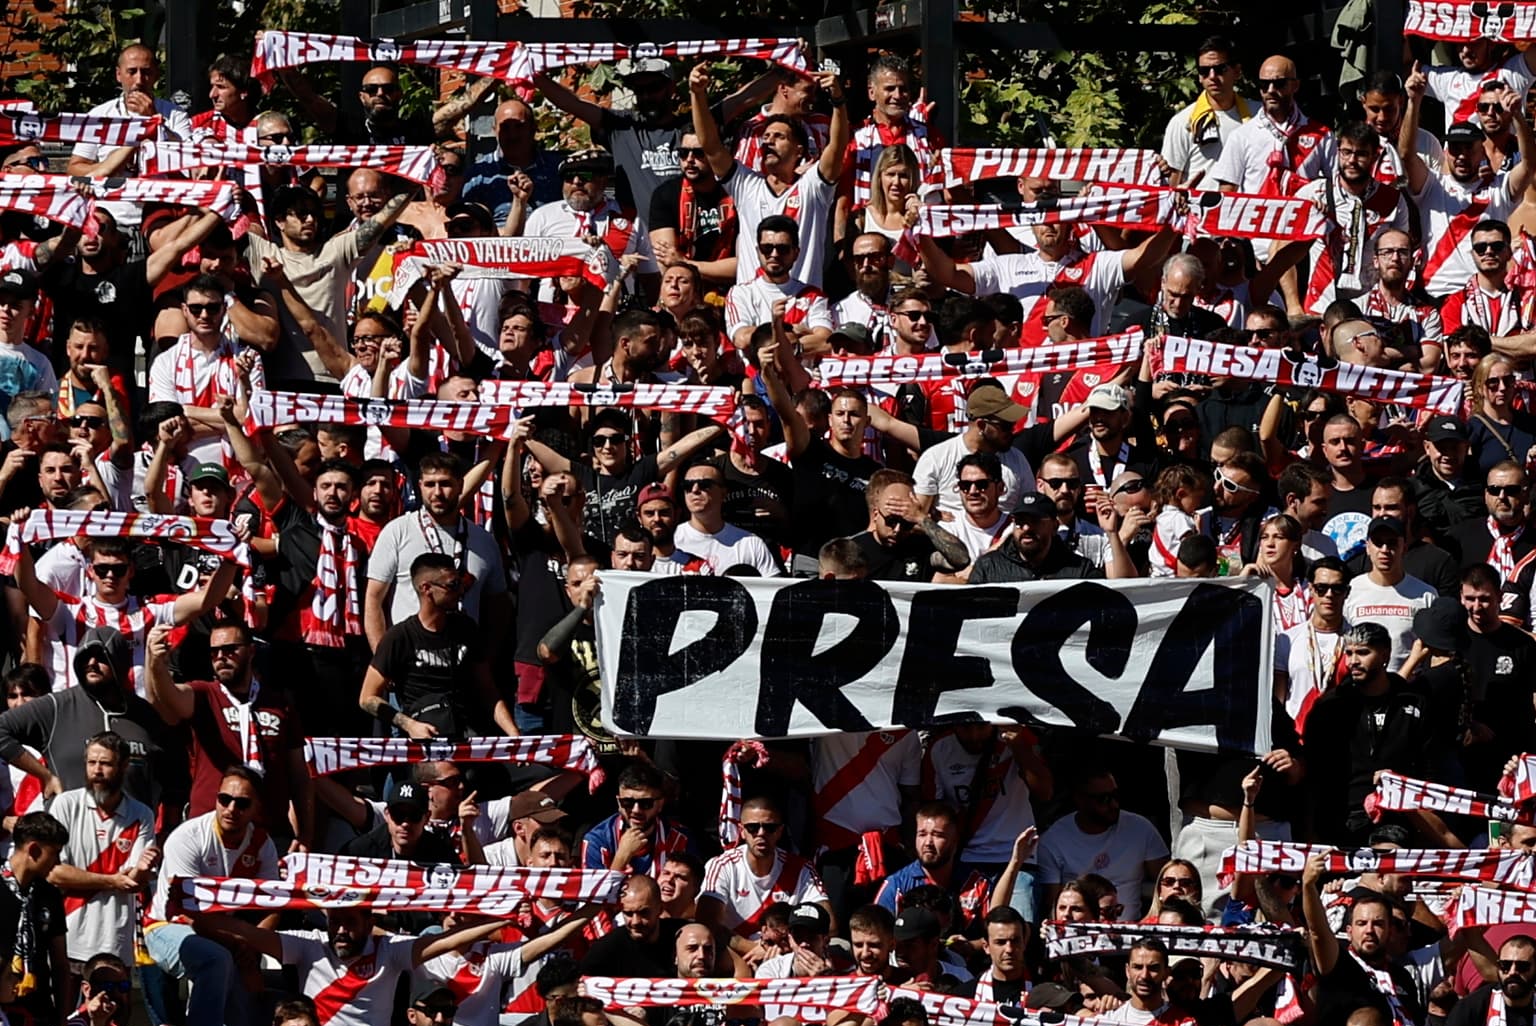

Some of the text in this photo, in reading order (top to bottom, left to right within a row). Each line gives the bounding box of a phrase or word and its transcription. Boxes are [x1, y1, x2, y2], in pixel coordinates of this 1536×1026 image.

[414, 40, 501, 75] VETE
[969, 148, 1077, 182] PUTO
[1216, 195, 1303, 235] VETE
[422, 237, 563, 265] RAYO VALLECANO
[820, 355, 943, 386] PRESA
[1004, 337, 1099, 375] VETE
[1164, 335, 1282, 380] PRESA
[1336, 361, 1425, 405] VETE
[405, 400, 497, 434] VETE
[1357, 606, 1410, 617] Bukaneros
[612, 574, 1263, 755] PRESA
[286, 852, 408, 888] PRESA
[474, 864, 567, 898] VETE
[1395, 848, 1489, 879] VETE
[192, 878, 295, 912] SOS
[581, 976, 689, 1006] SOS
